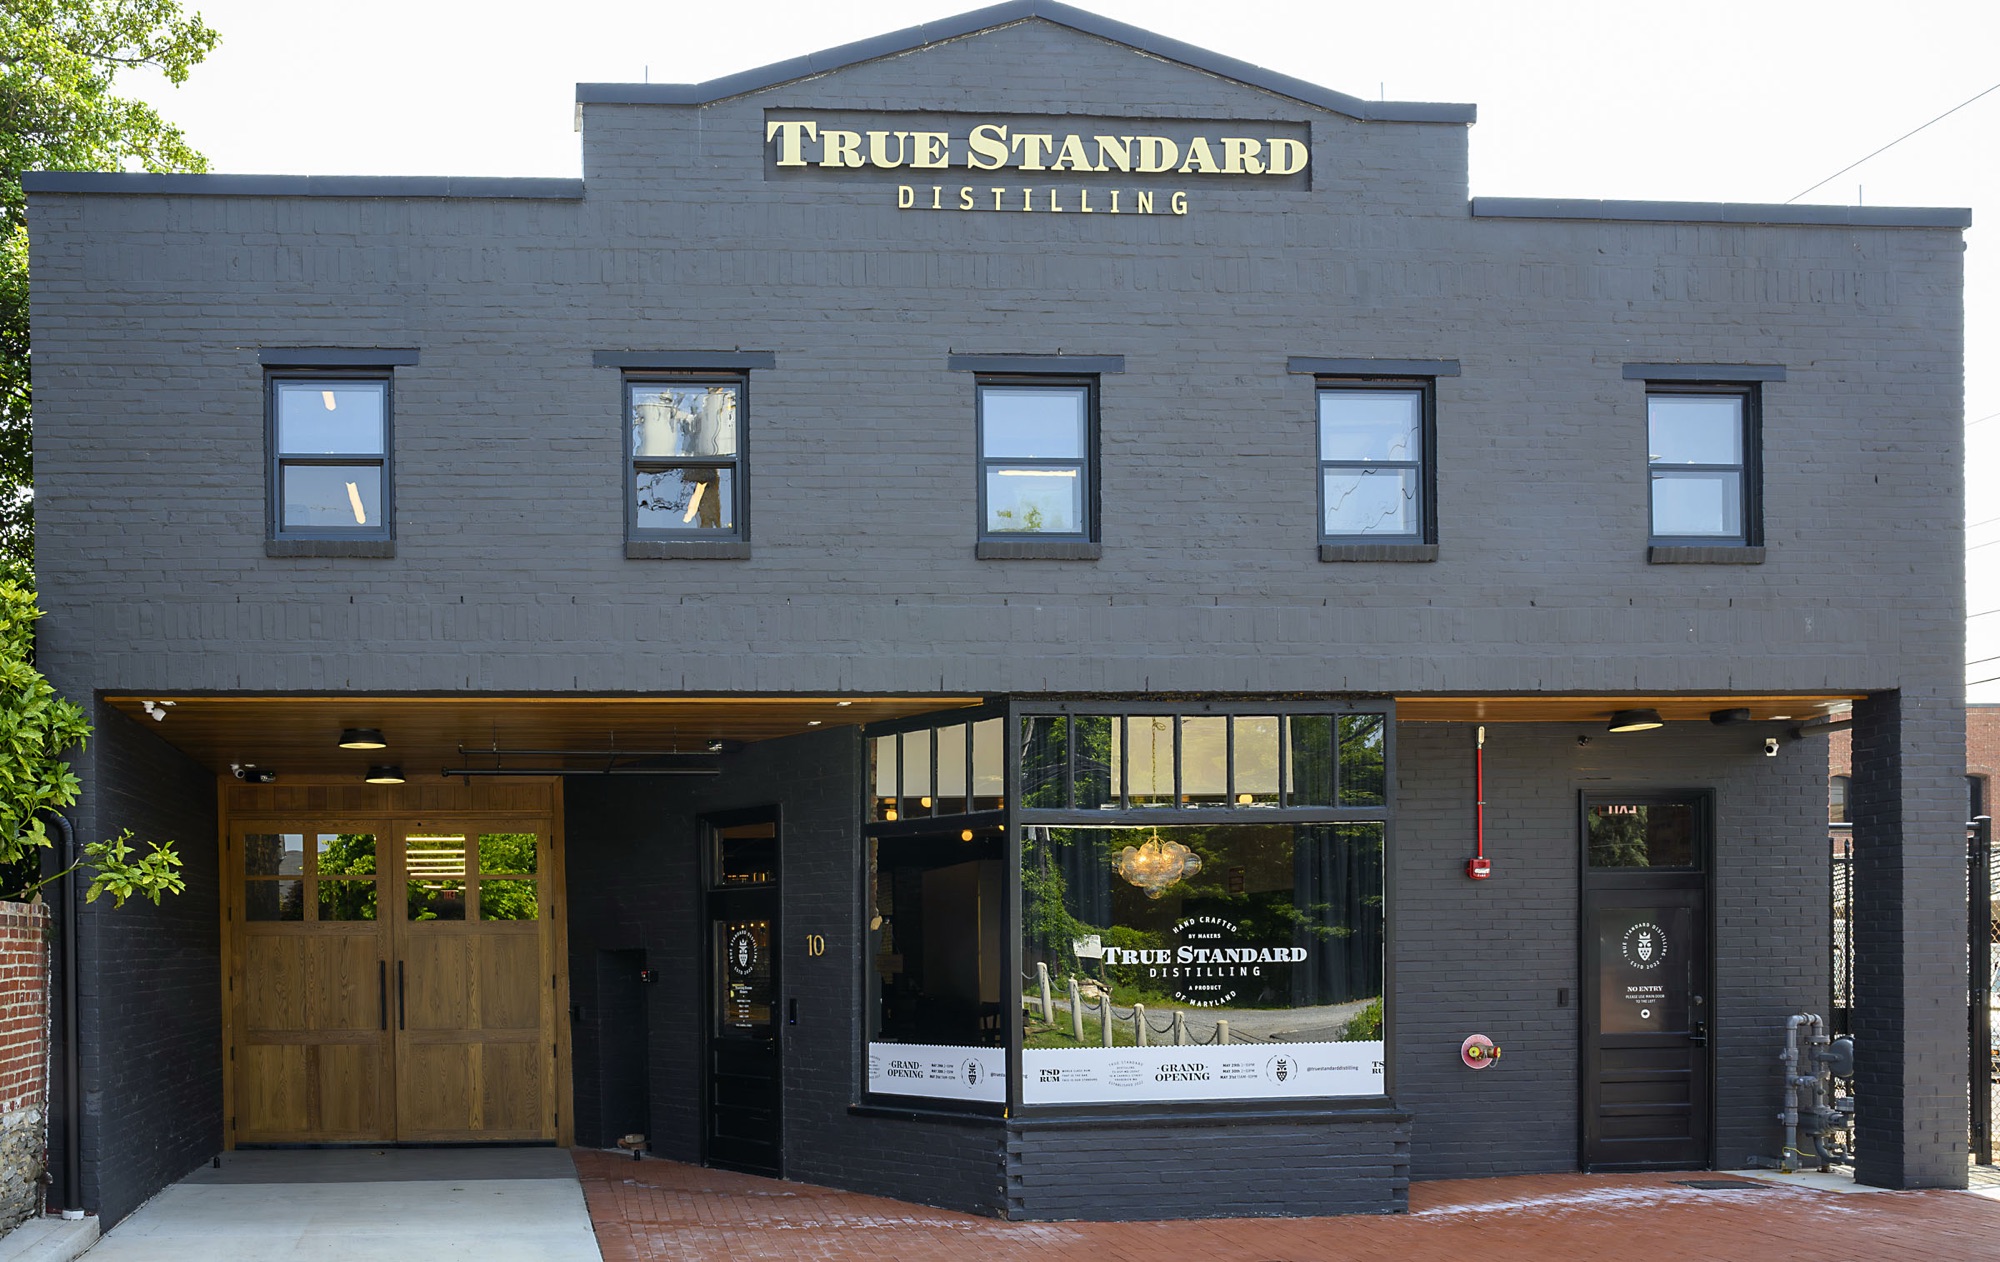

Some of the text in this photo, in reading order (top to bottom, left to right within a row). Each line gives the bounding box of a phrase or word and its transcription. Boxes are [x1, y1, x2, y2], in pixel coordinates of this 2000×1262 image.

[767, 121, 1309, 176] TRUE STANDARD
[899, 185, 1188, 215] DISTILLING
[1172, 916, 1237, 934] HAND CRAFTED
[806, 934, 825, 956] 10
[1102, 945, 1308, 965] TRUE STANDARD
[1149, 966, 1260, 978] DISTILLING
[1175, 990, 1237, 1008] OF MARYLAND
[887, 1068, 924, 1079] OPENING
[1155, 1072, 1210, 1082] OPENING
